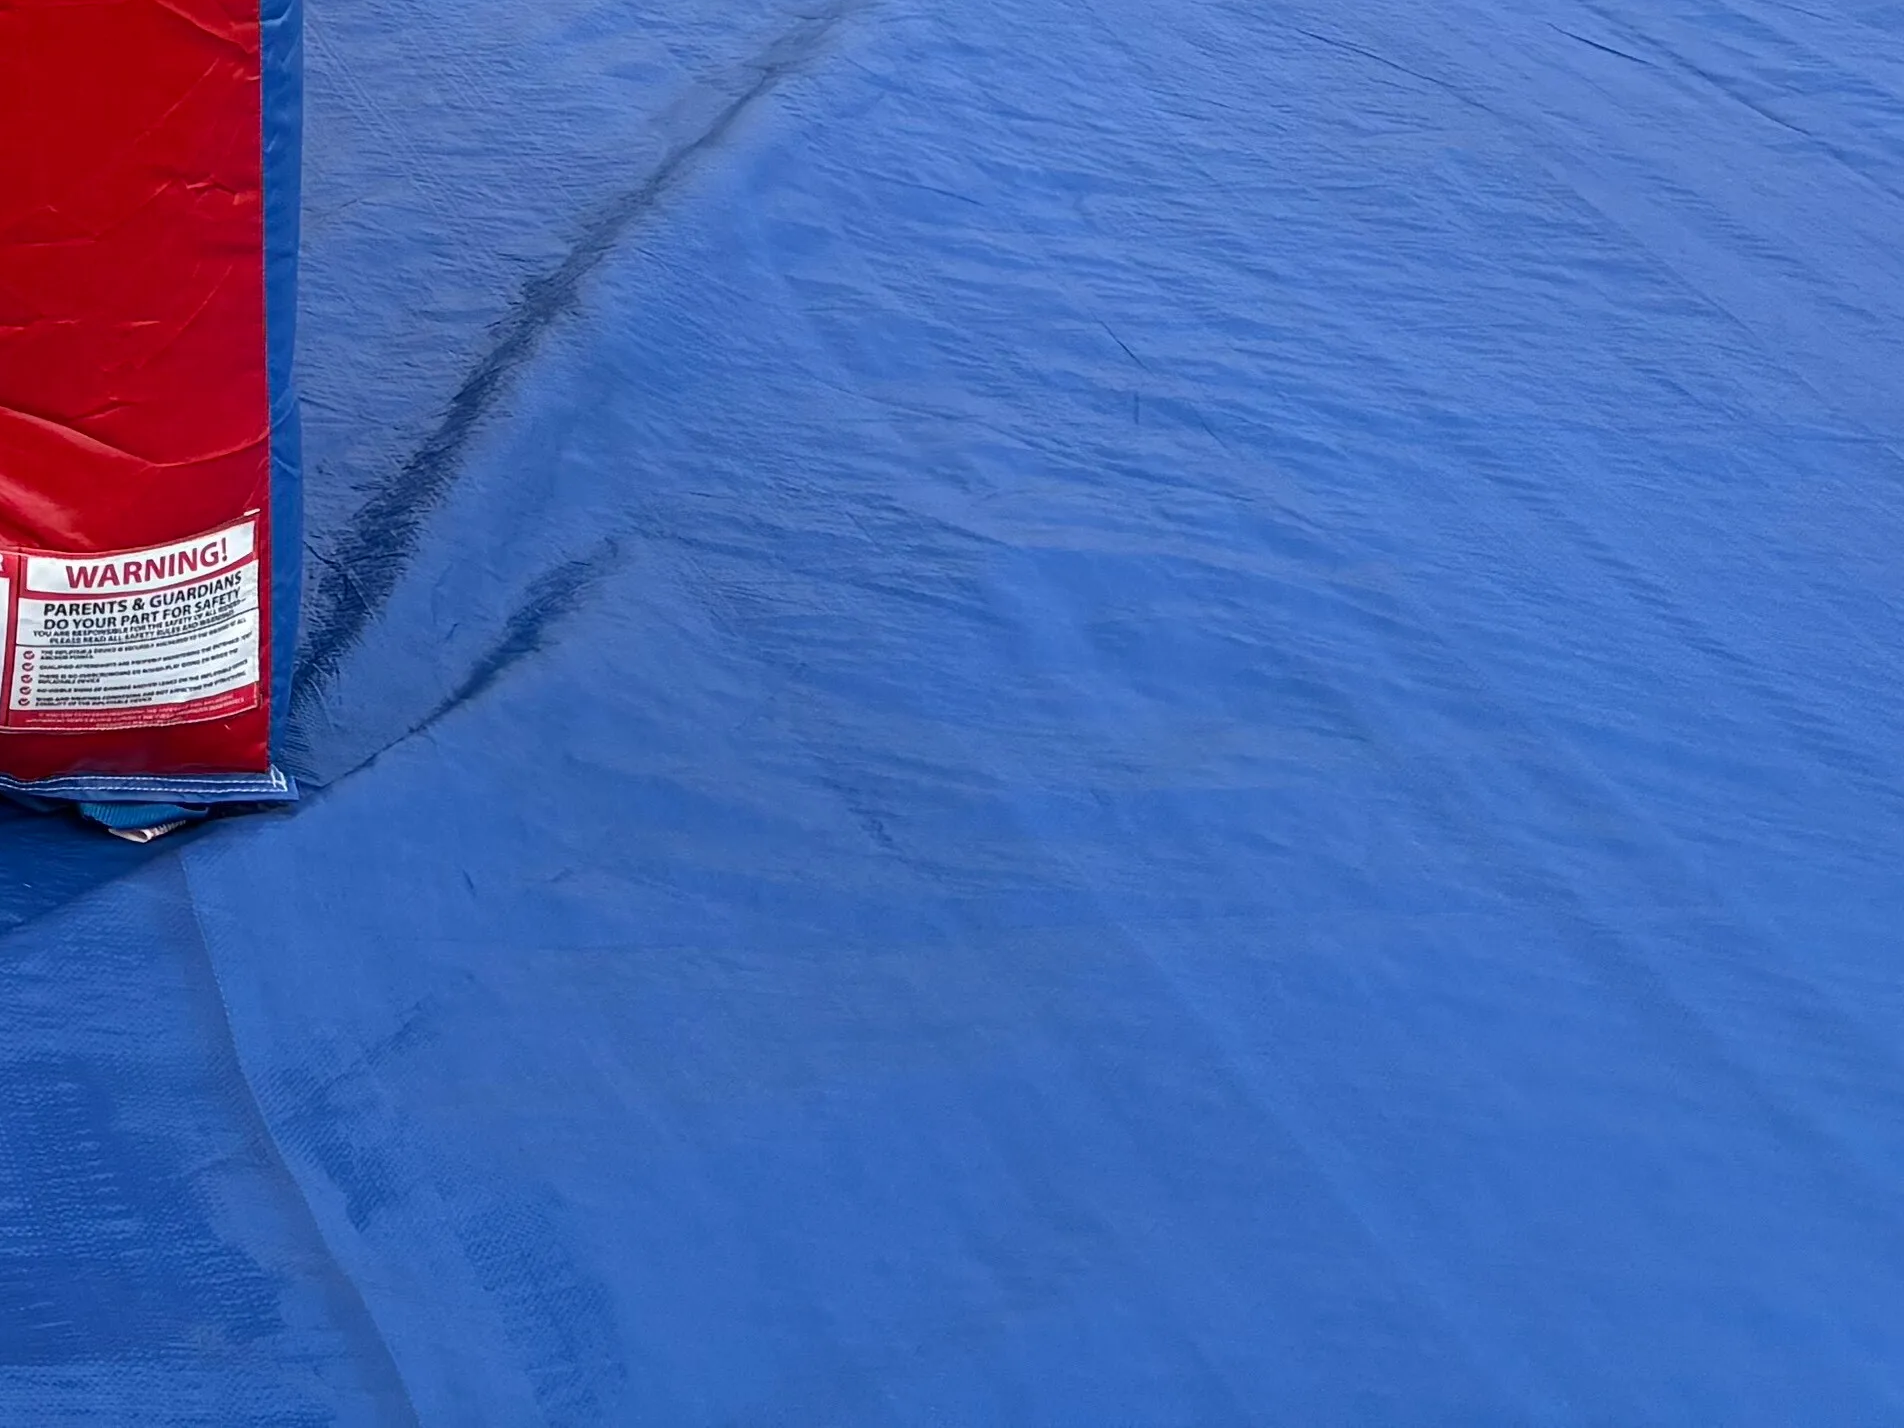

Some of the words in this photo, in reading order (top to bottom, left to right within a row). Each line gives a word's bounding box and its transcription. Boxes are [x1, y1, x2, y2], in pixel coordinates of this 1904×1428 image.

[66, 537, 228, 589] WARNING!
[44, 600, 127, 616] PARENTS
[132, 598, 145, 610] &
[149, 571, 242, 608] GUARDIANS
[44, 619, 69, 630] DO
[73, 617, 117, 629] YOUR
[120, 610, 160, 627] PART
[163, 605, 192, 620] FOR
[194, 587, 241, 613] SAFETY
[33, 630, 51, 638] YOU
[72, 627, 128, 637] RESPONSIBLE
[130, 625, 146, 633] FOR
[83, 635, 106, 643] READ
[109, 634, 123, 642] ALL
[125, 631, 154, 641] SAFETY
